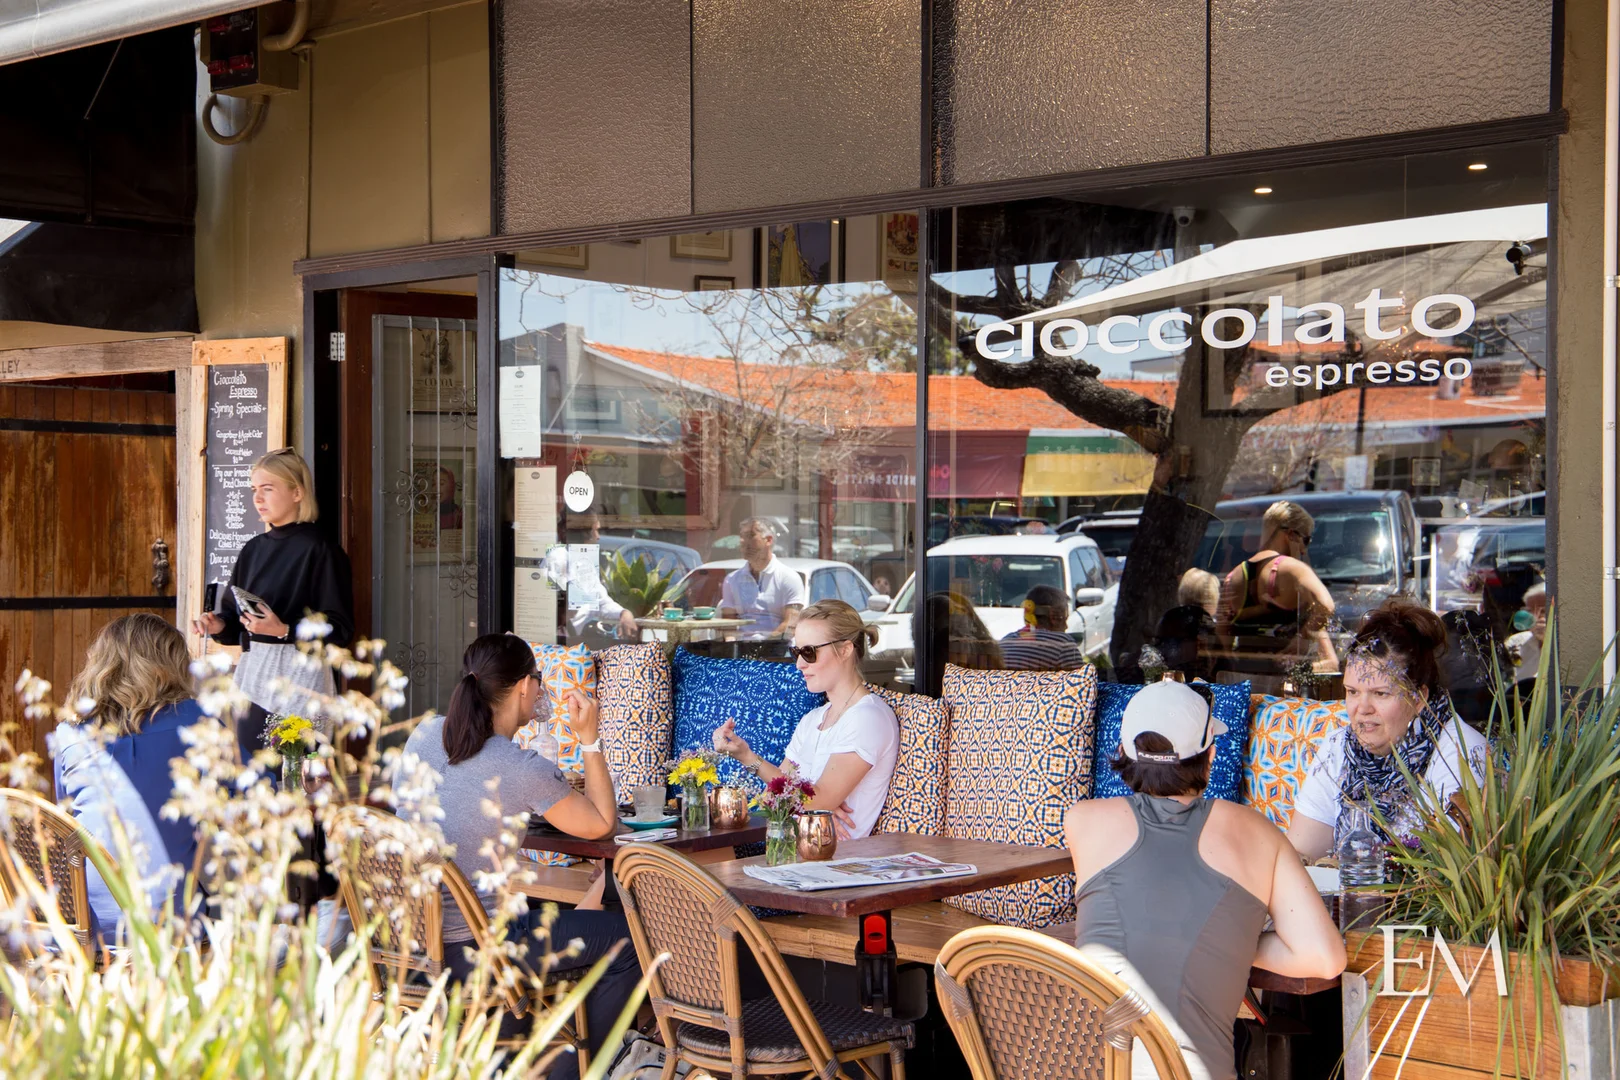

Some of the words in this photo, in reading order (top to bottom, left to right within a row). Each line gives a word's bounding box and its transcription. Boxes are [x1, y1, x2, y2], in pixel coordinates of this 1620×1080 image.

[975, 288, 1476, 360] cioccolato
[0, 359, 20, 374] LEY
[1265, 357, 1473, 390] espresso
[213, 370, 247, 386] Cioccolato
[229, 385, 258, 399] Espresso
[214, 401, 234, 418] Spring
[236, 402, 262, 419] Specials
[213, 467, 224, 483] Try
[223, 470, 233, 478] our
[568, 486, 589, 496] OPEN
